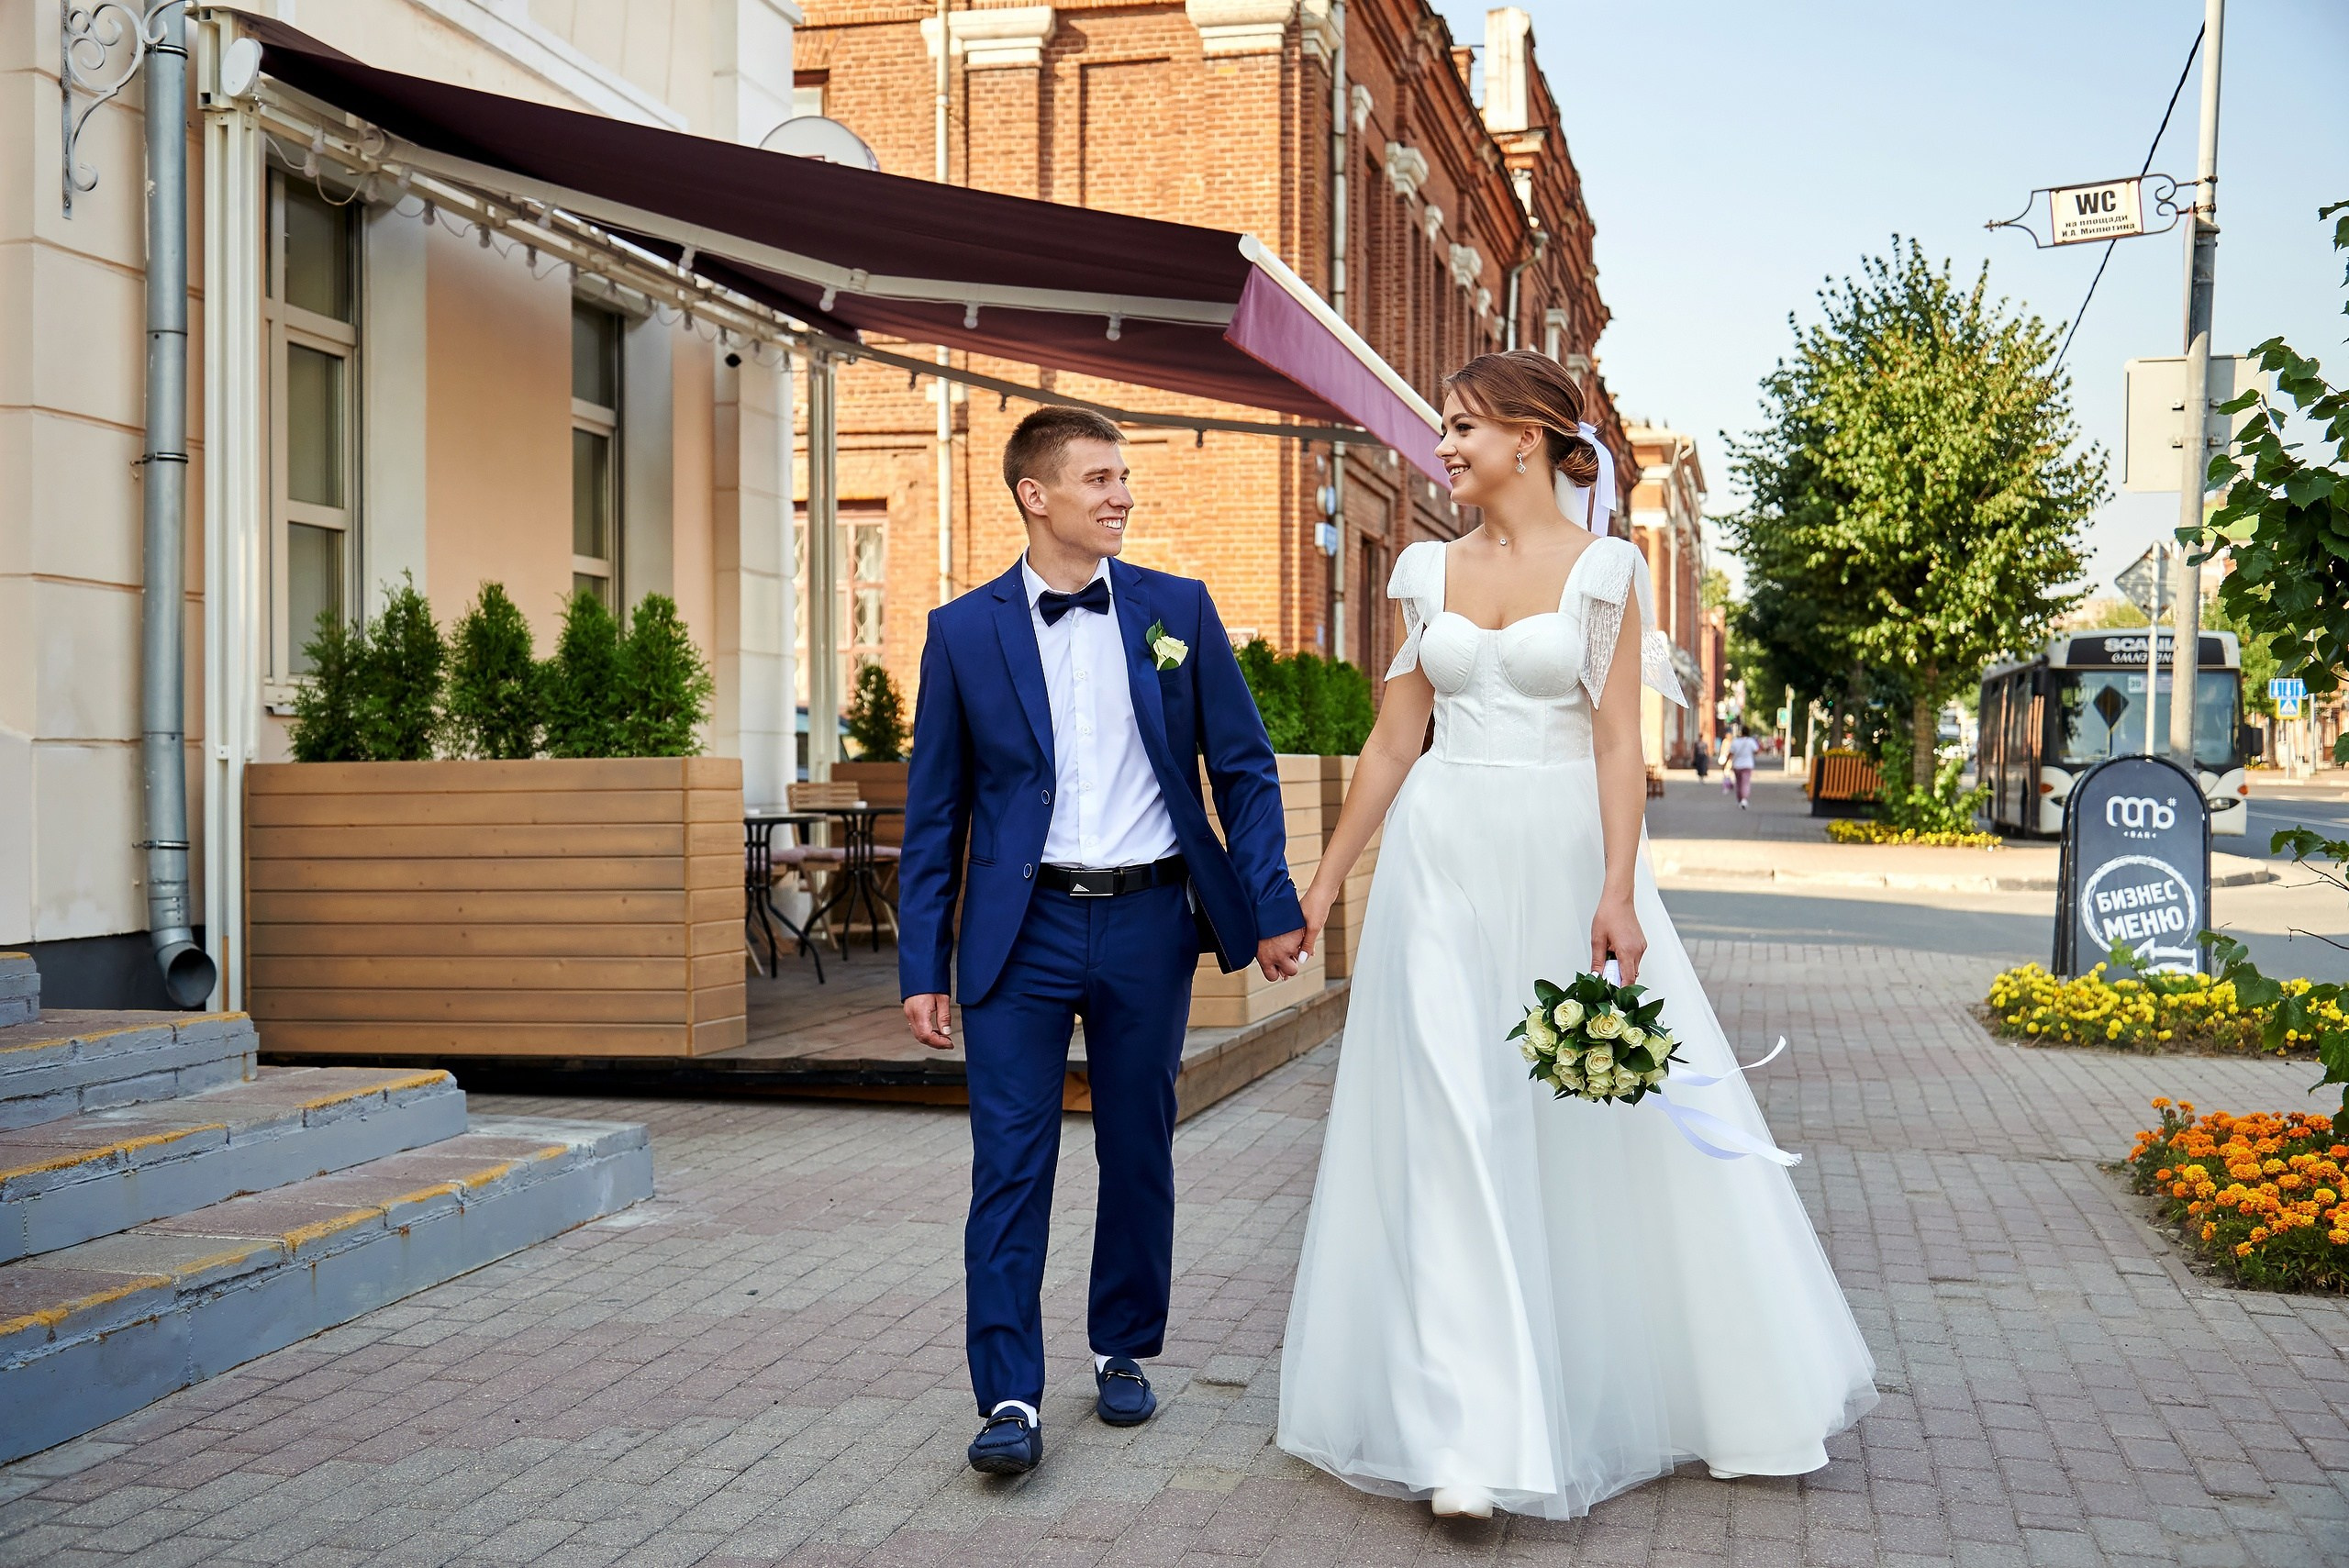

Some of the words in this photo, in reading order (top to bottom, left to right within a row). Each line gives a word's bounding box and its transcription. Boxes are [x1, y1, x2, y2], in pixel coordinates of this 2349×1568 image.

[2076, 190, 2116, 216] WC
[2079, 215, 2128, 226] площади
[2080, 223, 2135, 235] Милютина
[2096, 879, 2178, 914] БИЗНЕС
[2102, 905, 2185, 942] МЕНЮ
